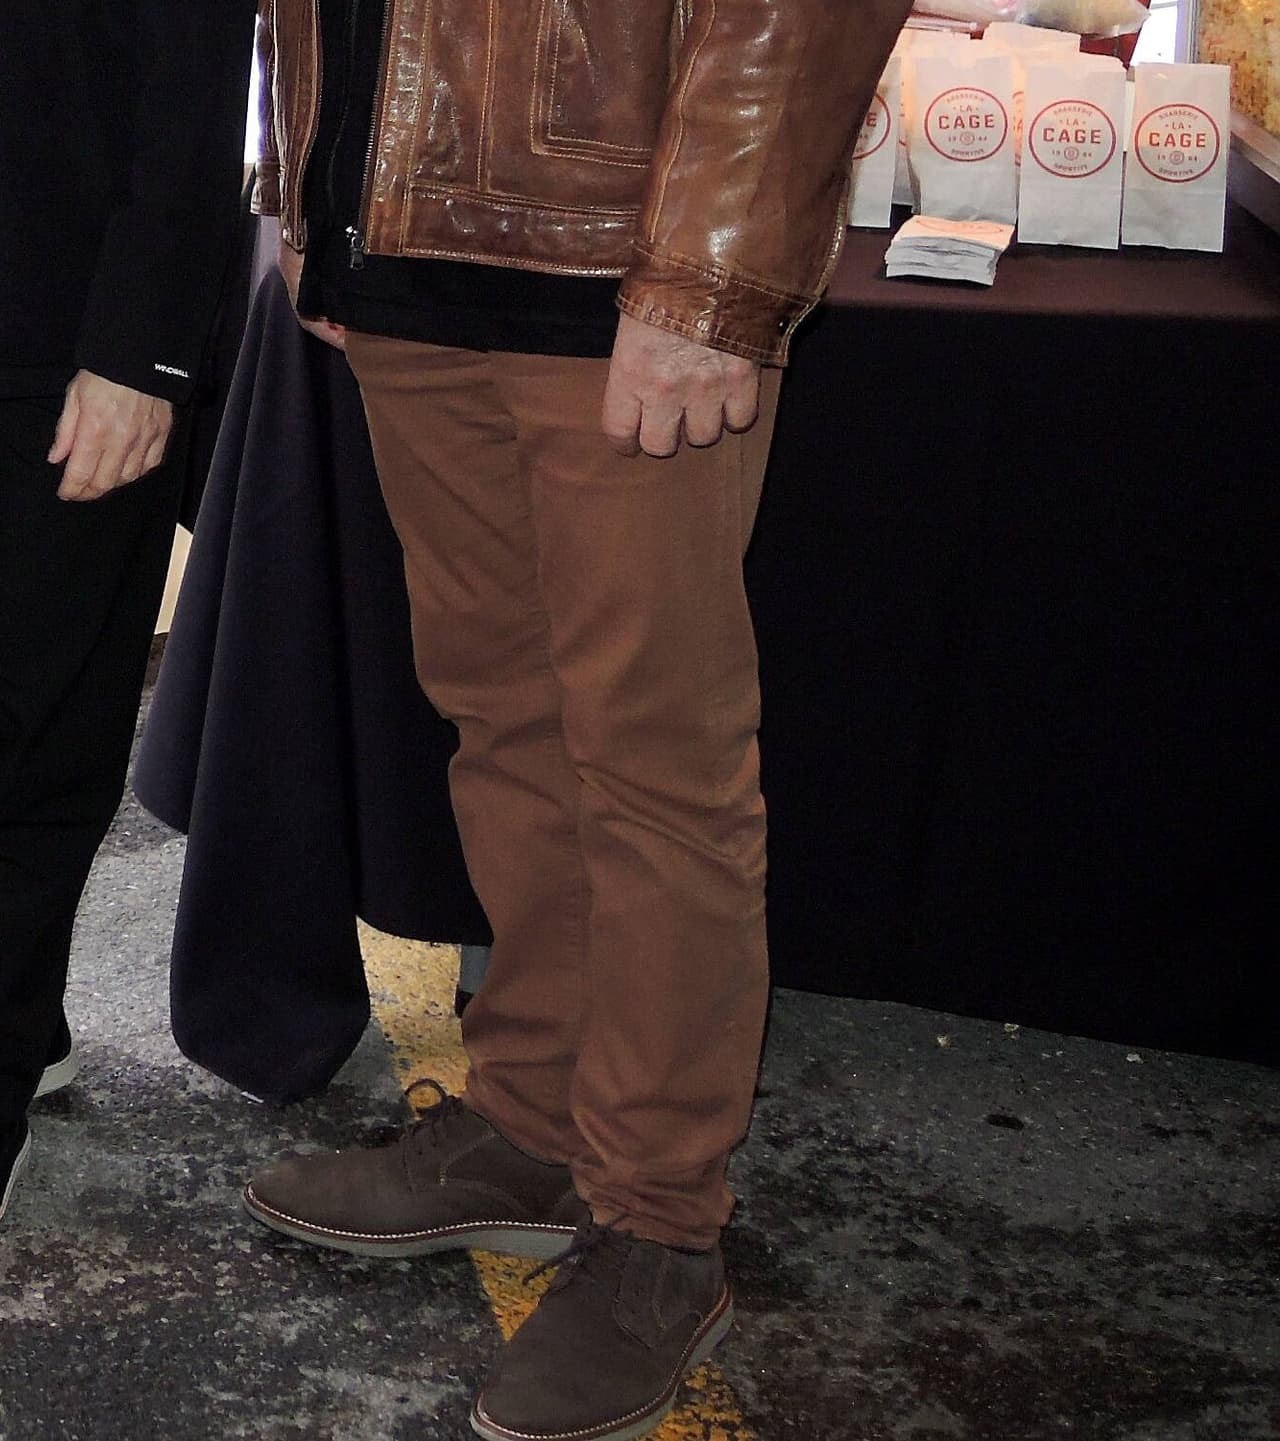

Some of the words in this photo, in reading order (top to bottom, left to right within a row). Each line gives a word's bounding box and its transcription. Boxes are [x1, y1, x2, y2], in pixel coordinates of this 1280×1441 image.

[938, 114, 995, 130] CAGE
[1066, 118, 1079, 126] LA
[1171, 122, 1184, 130] LA
[1043, 127, 1102, 144] CAGE
[1148, 132, 1207, 148] CAGE
